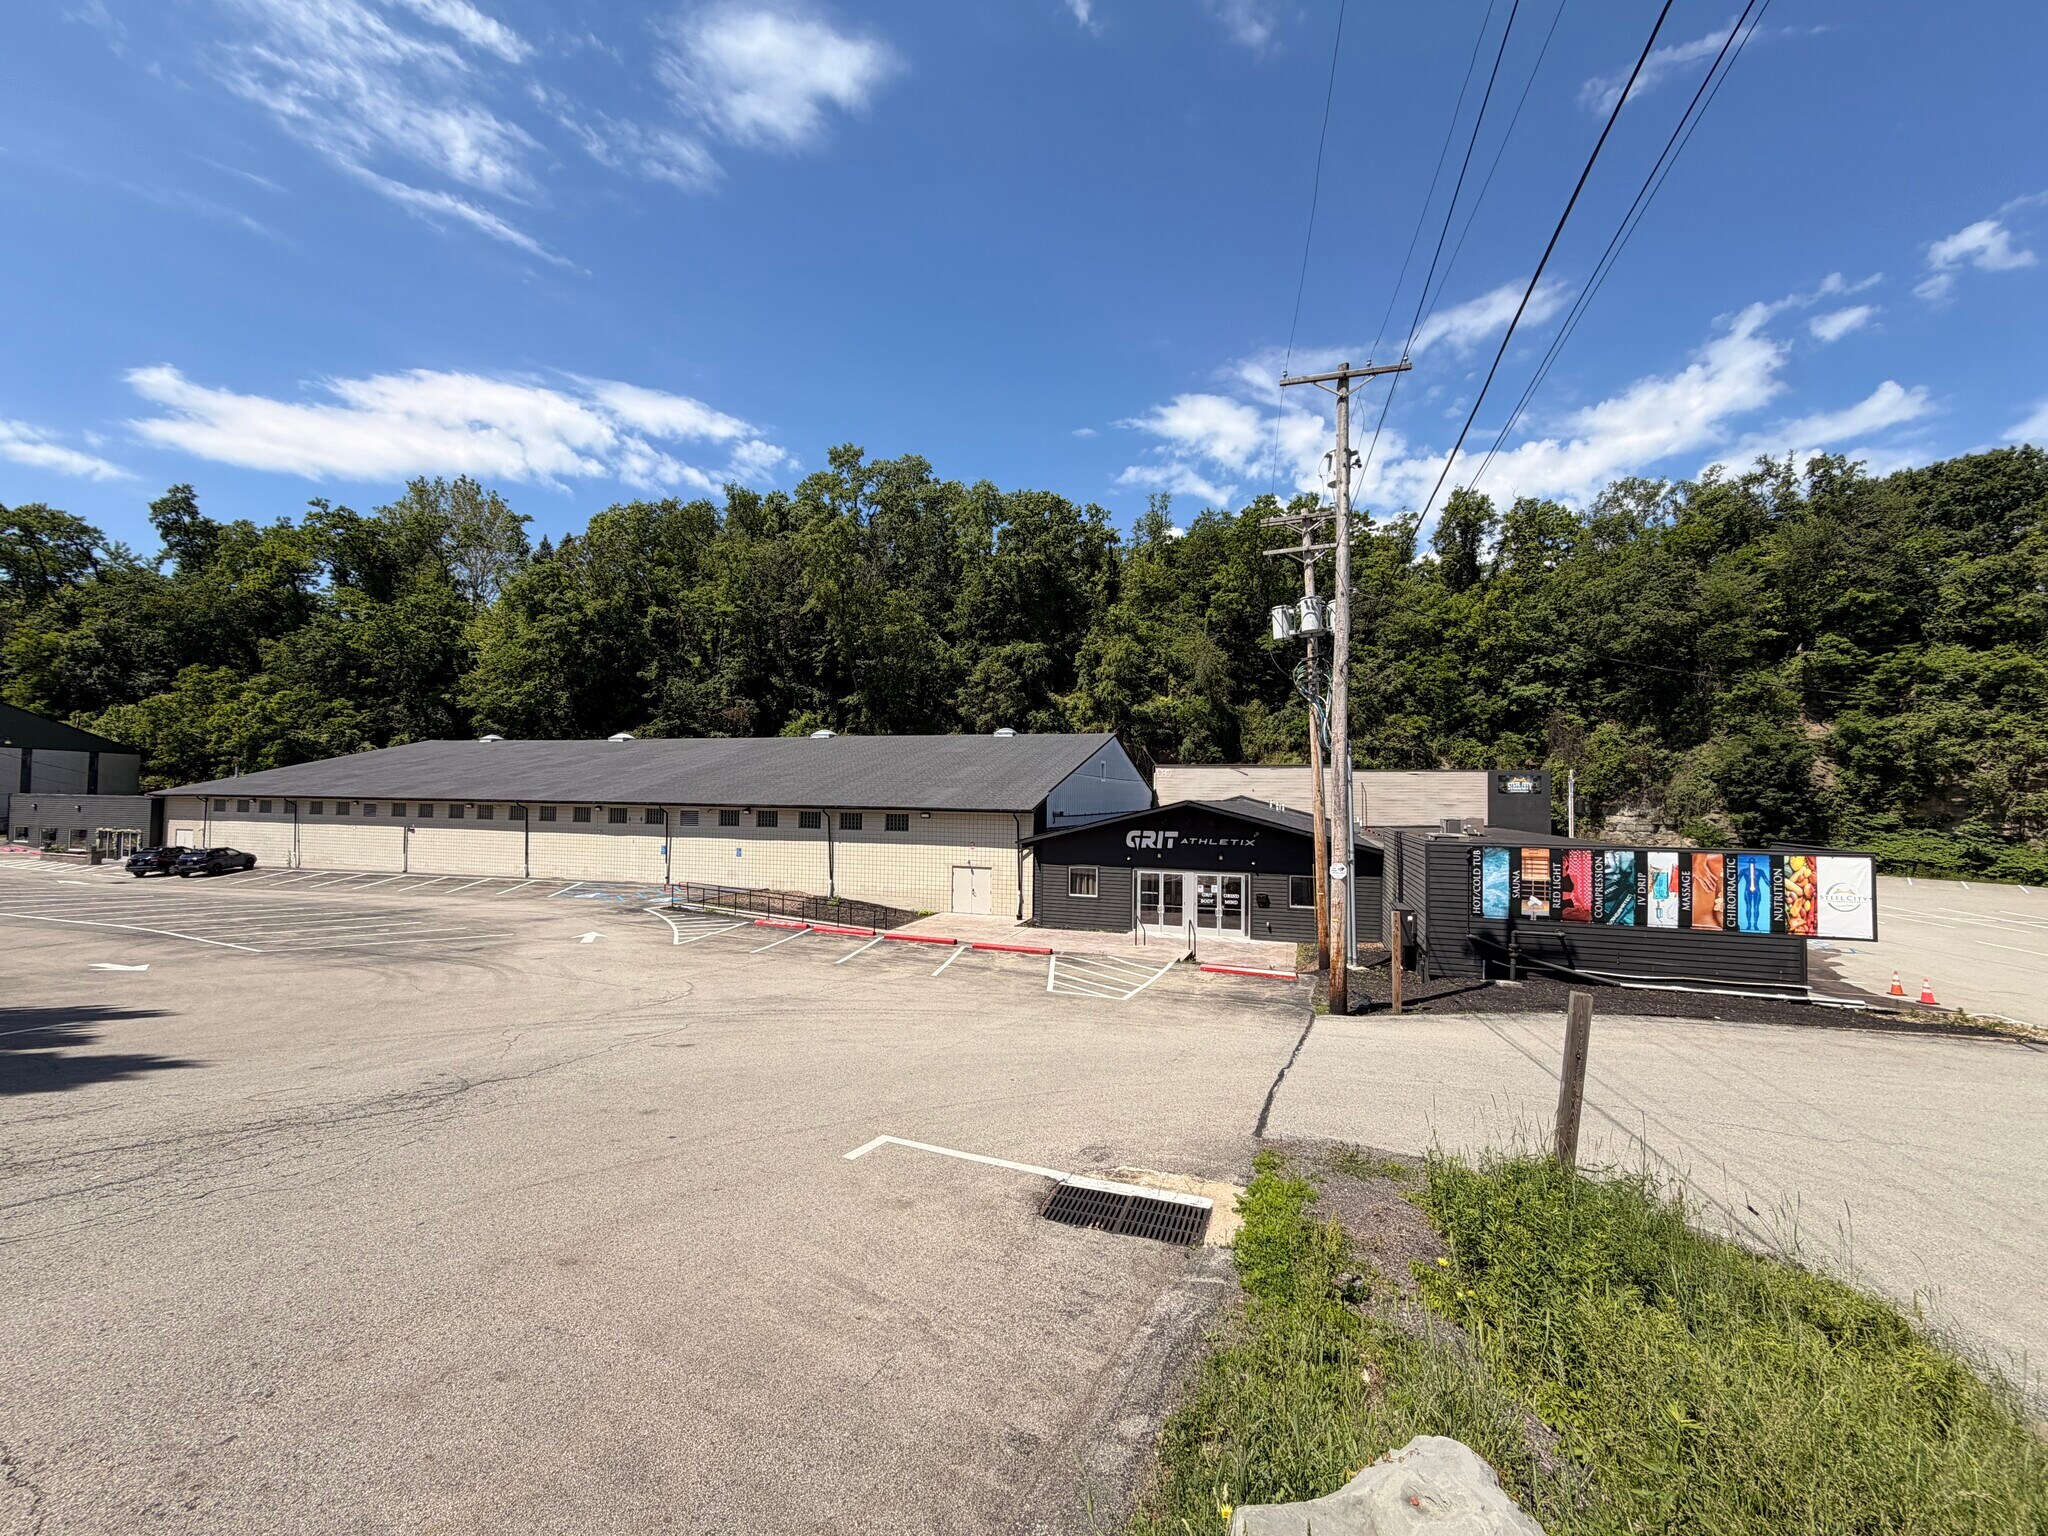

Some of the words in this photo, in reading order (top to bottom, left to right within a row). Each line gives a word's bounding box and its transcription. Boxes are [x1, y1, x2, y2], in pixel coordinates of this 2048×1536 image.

[1126, 830, 1179, 850] GRIT
[1180, 834, 1259, 847] ATHLETIX
[1472, 850, 1481, 866] TUB
[1512, 870, 1520, 898] SAUNA
[1552, 863, 1561, 889] LIGHT
[1594, 856, 1604, 918] COMPRESSION
[1637, 872, 1646, 893] DRIP
[1472, 868, 1481, 914] HOT/COLD
[1552, 891, 1561, 908] RED
[1637, 896, 1646, 905] IV
[1681, 870, 1691, 911] MASSAGE
[1726, 858, 1736, 927] CHIROPRACTIC
[1773, 868, 1784, 921] NUTRITION
